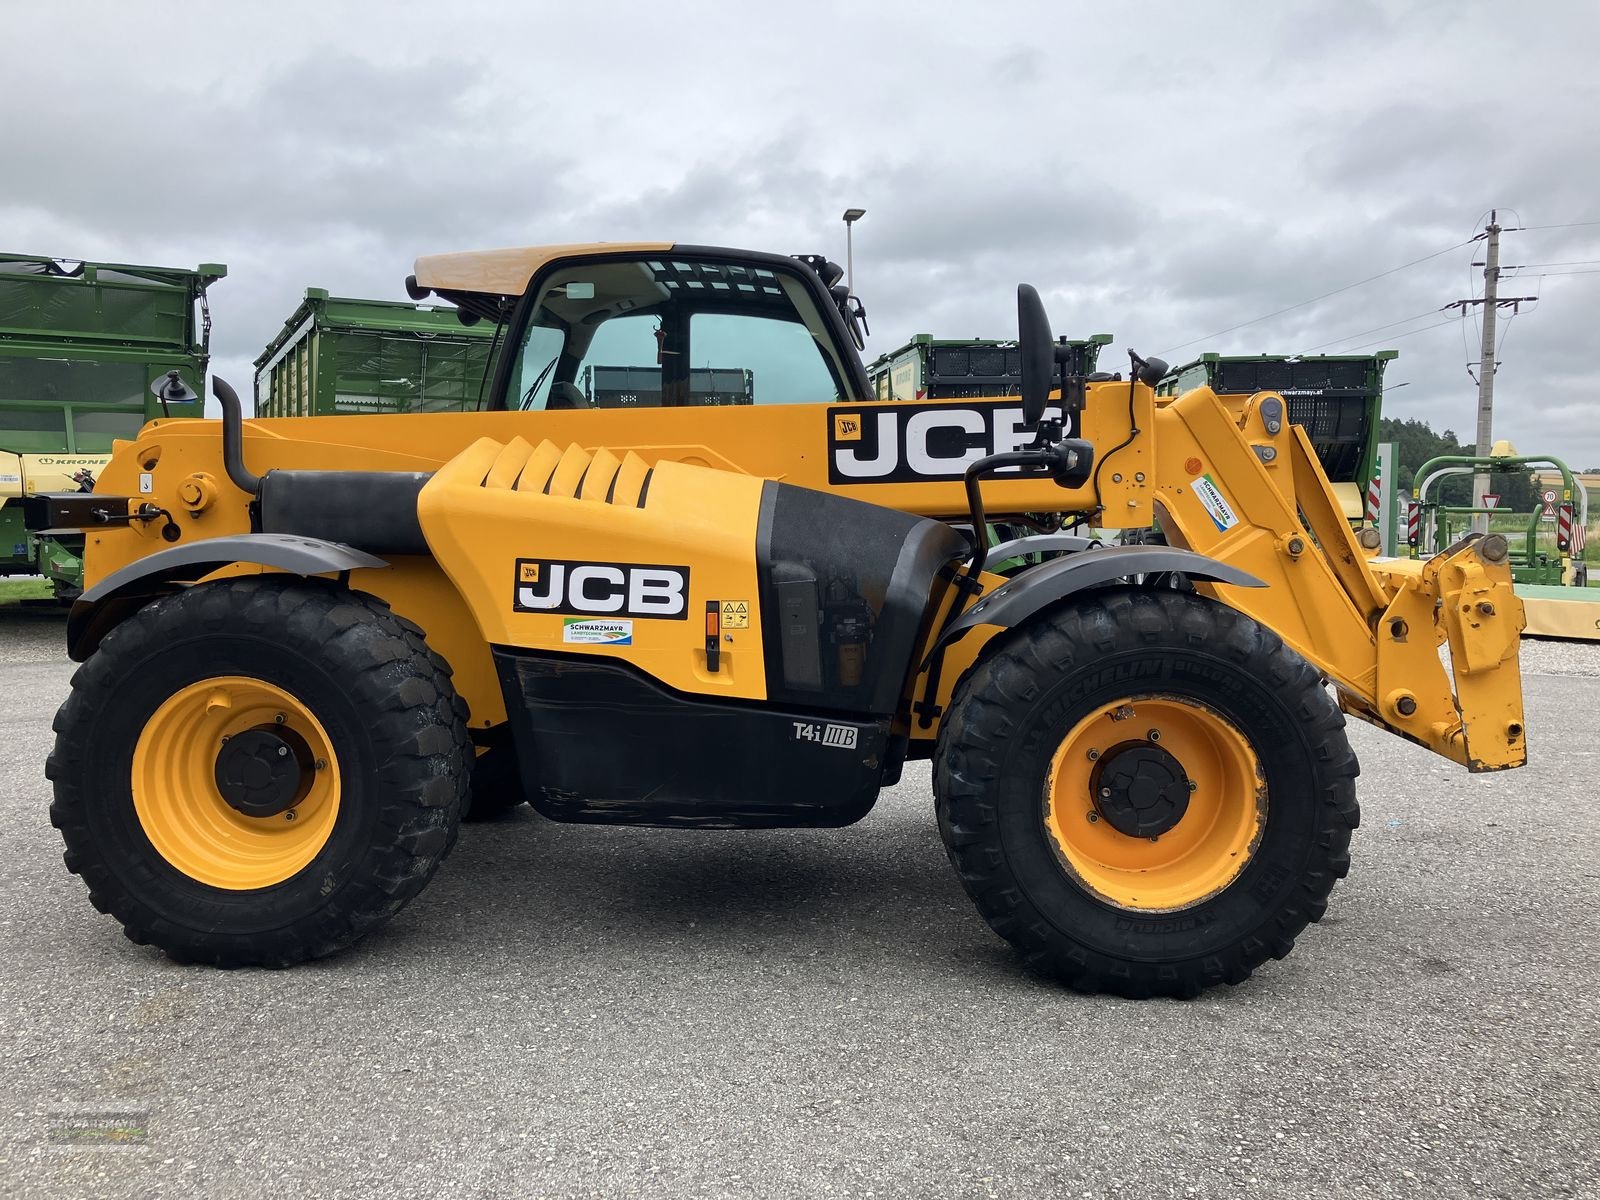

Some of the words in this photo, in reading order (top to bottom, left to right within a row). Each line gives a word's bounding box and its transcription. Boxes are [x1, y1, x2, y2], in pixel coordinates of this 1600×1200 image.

[842, 421, 857, 433] JCB
[1202, 480, 1231, 520] SCHWARZMAYR
[1546, 493, 1554, 501] 70
[519, 564, 684, 615] JCB
[570, 624, 624, 632] SCHWARZMAYR
[1042, 658, 1162, 723] MICHELIN
[793, 722, 821, 742] T4i
